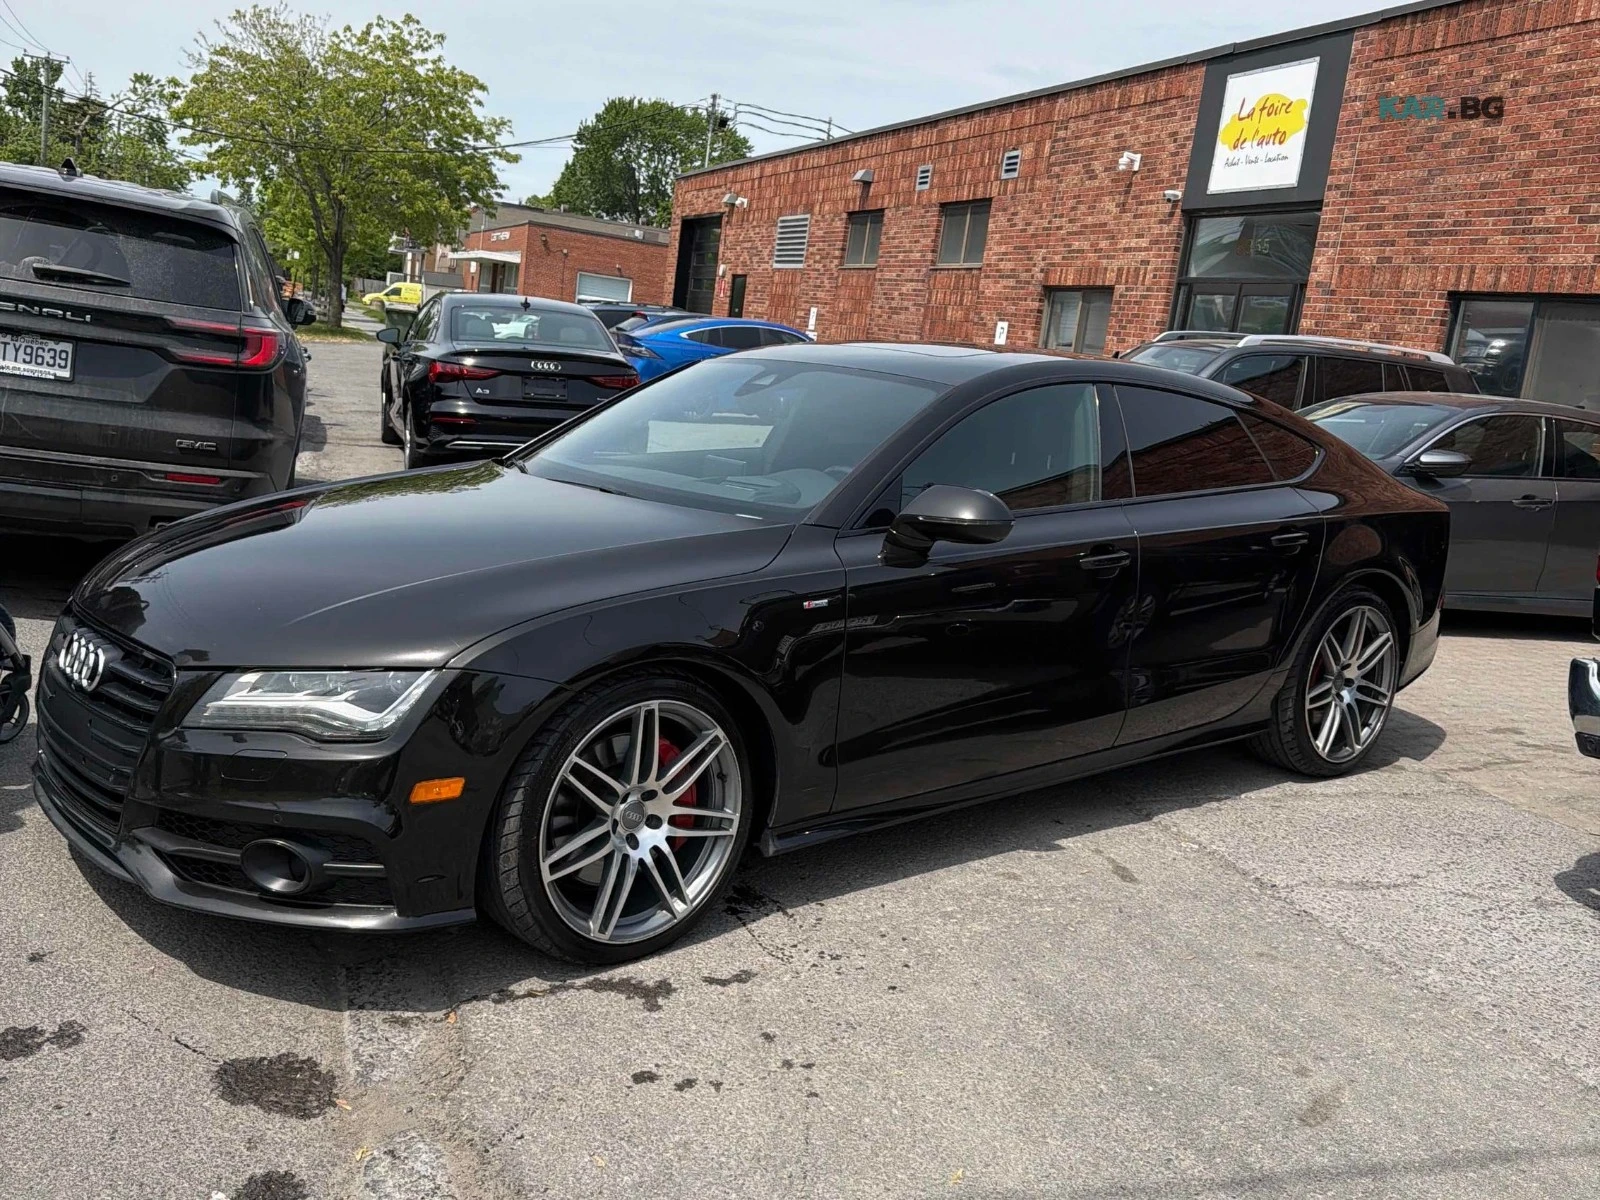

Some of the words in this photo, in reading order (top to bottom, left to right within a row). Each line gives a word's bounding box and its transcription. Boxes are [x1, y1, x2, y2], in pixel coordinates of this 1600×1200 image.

[1238, 97, 1255, 122] La
[1258, 97, 1294, 124] foire
[1233, 128, 1247, 150] de
[1251, 128, 1287, 150] l'auto
[1264, 152, 1289, 164] Location
[175, 439, 217, 451] GMC
